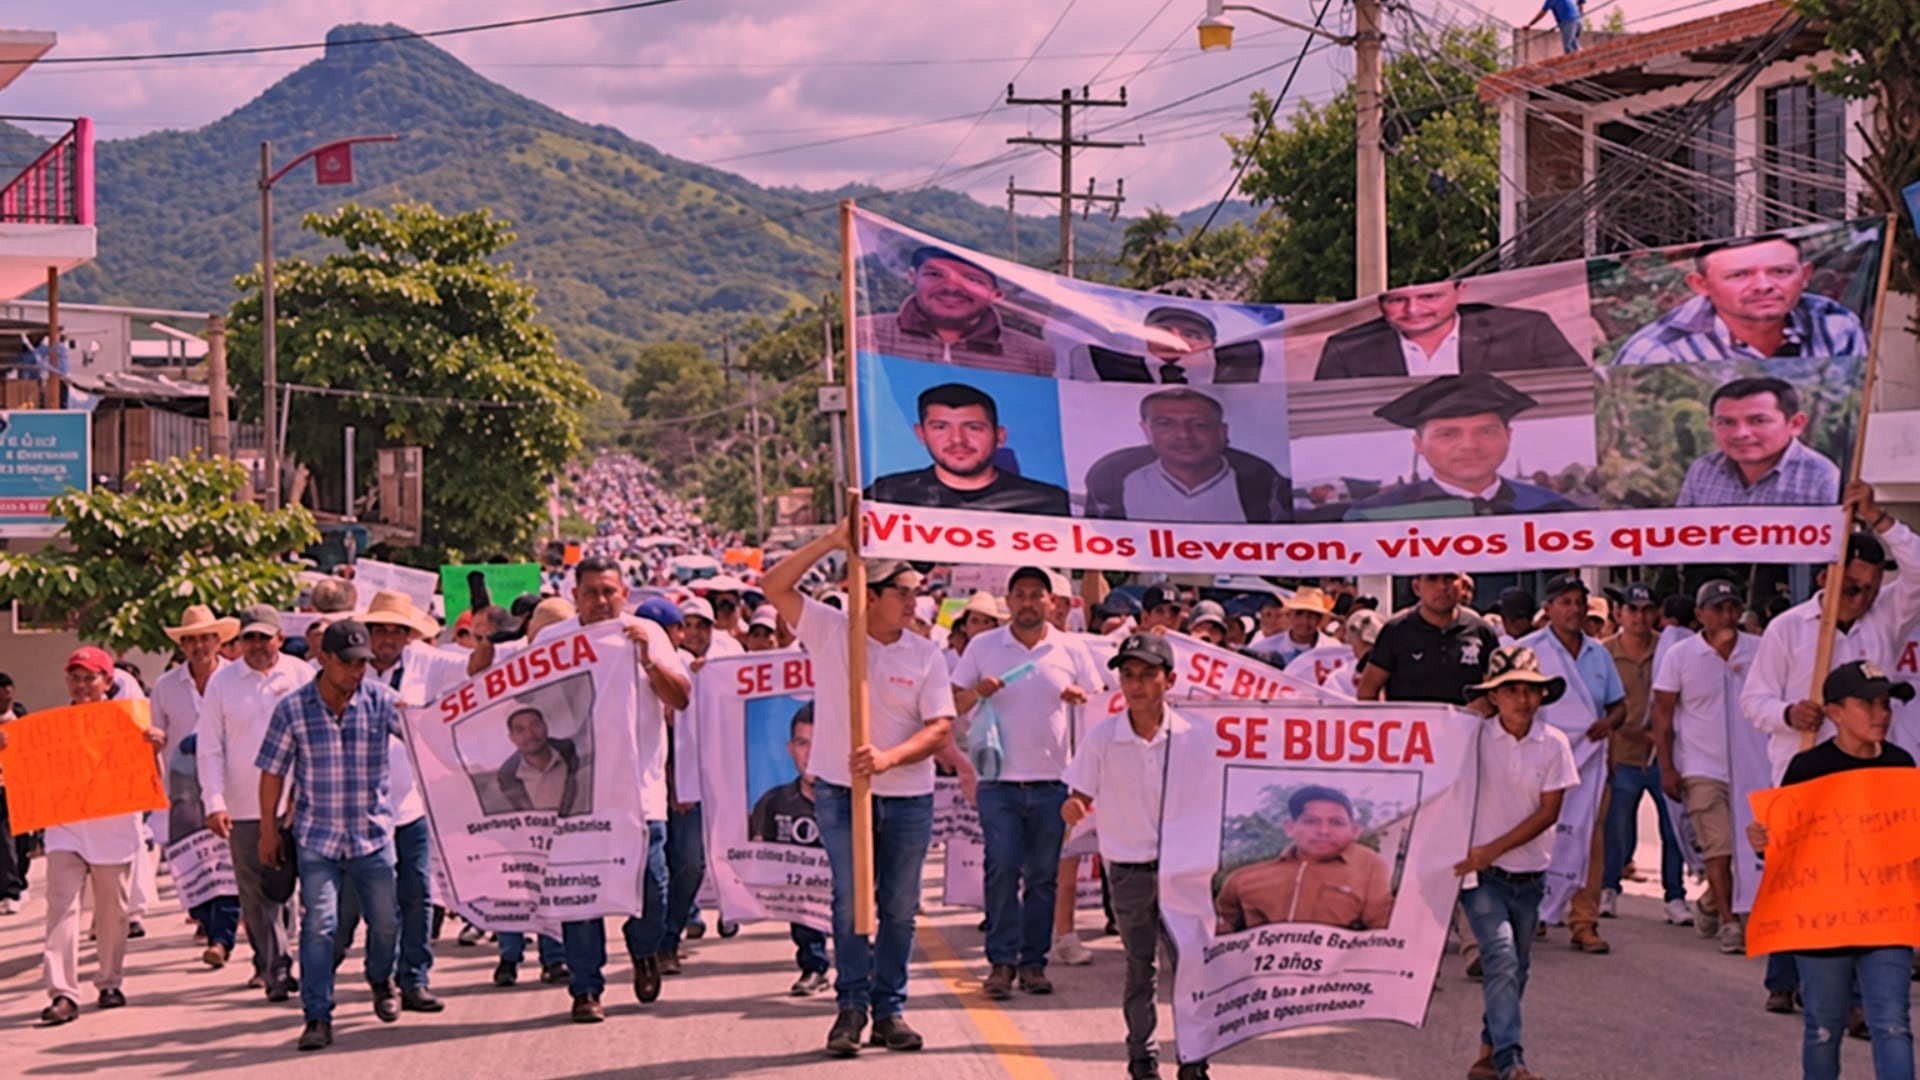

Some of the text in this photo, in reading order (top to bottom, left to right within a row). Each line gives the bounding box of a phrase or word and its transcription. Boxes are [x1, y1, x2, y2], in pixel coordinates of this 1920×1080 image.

[1012, 531, 1058, 552] se
[1072, 525, 1136, 557] los
[1149, 529, 1362, 564] llevaron,
[1376, 527, 1508, 558] vivos
[1524, 521, 1594, 552] los
[1610, 523, 1832, 556] queremos
[439, 633, 598, 724] SE BUSCA
[736, 663, 773, 695] SE
[1187, 652, 1228, 690] SE
[1215, 716, 1434, 764] SE BUSCA
[1254, 952, 1323, 972] 12 años
